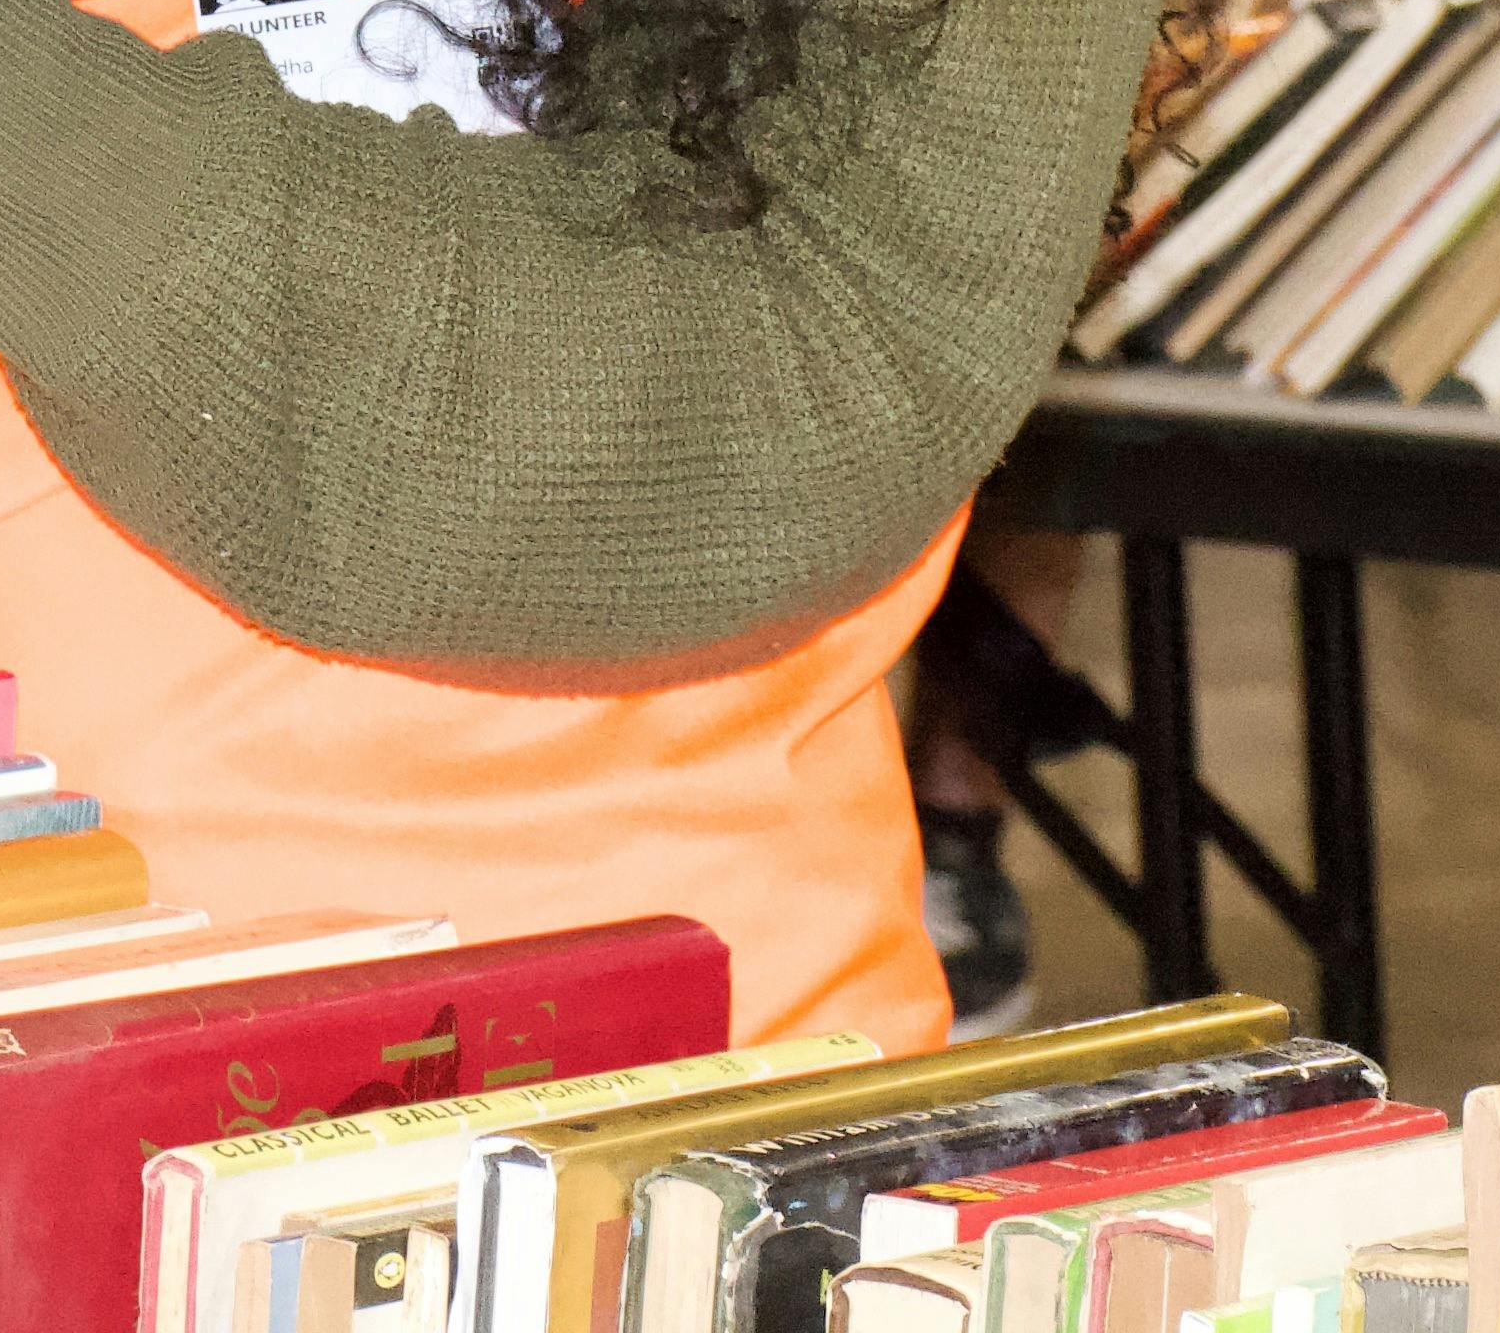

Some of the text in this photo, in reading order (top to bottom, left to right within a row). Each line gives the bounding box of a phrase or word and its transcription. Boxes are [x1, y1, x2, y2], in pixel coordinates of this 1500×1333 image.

[224, 10, 328, 36] OLUNTEER
[279, 58, 315, 76] dha
[210, 1118, 370, 1160] CLASSICAL
[386, 1096, 492, 1127] BALLET
[514, 1069, 646, 1113] VAGANOVA
[728, 1117, 901, 1155] William
